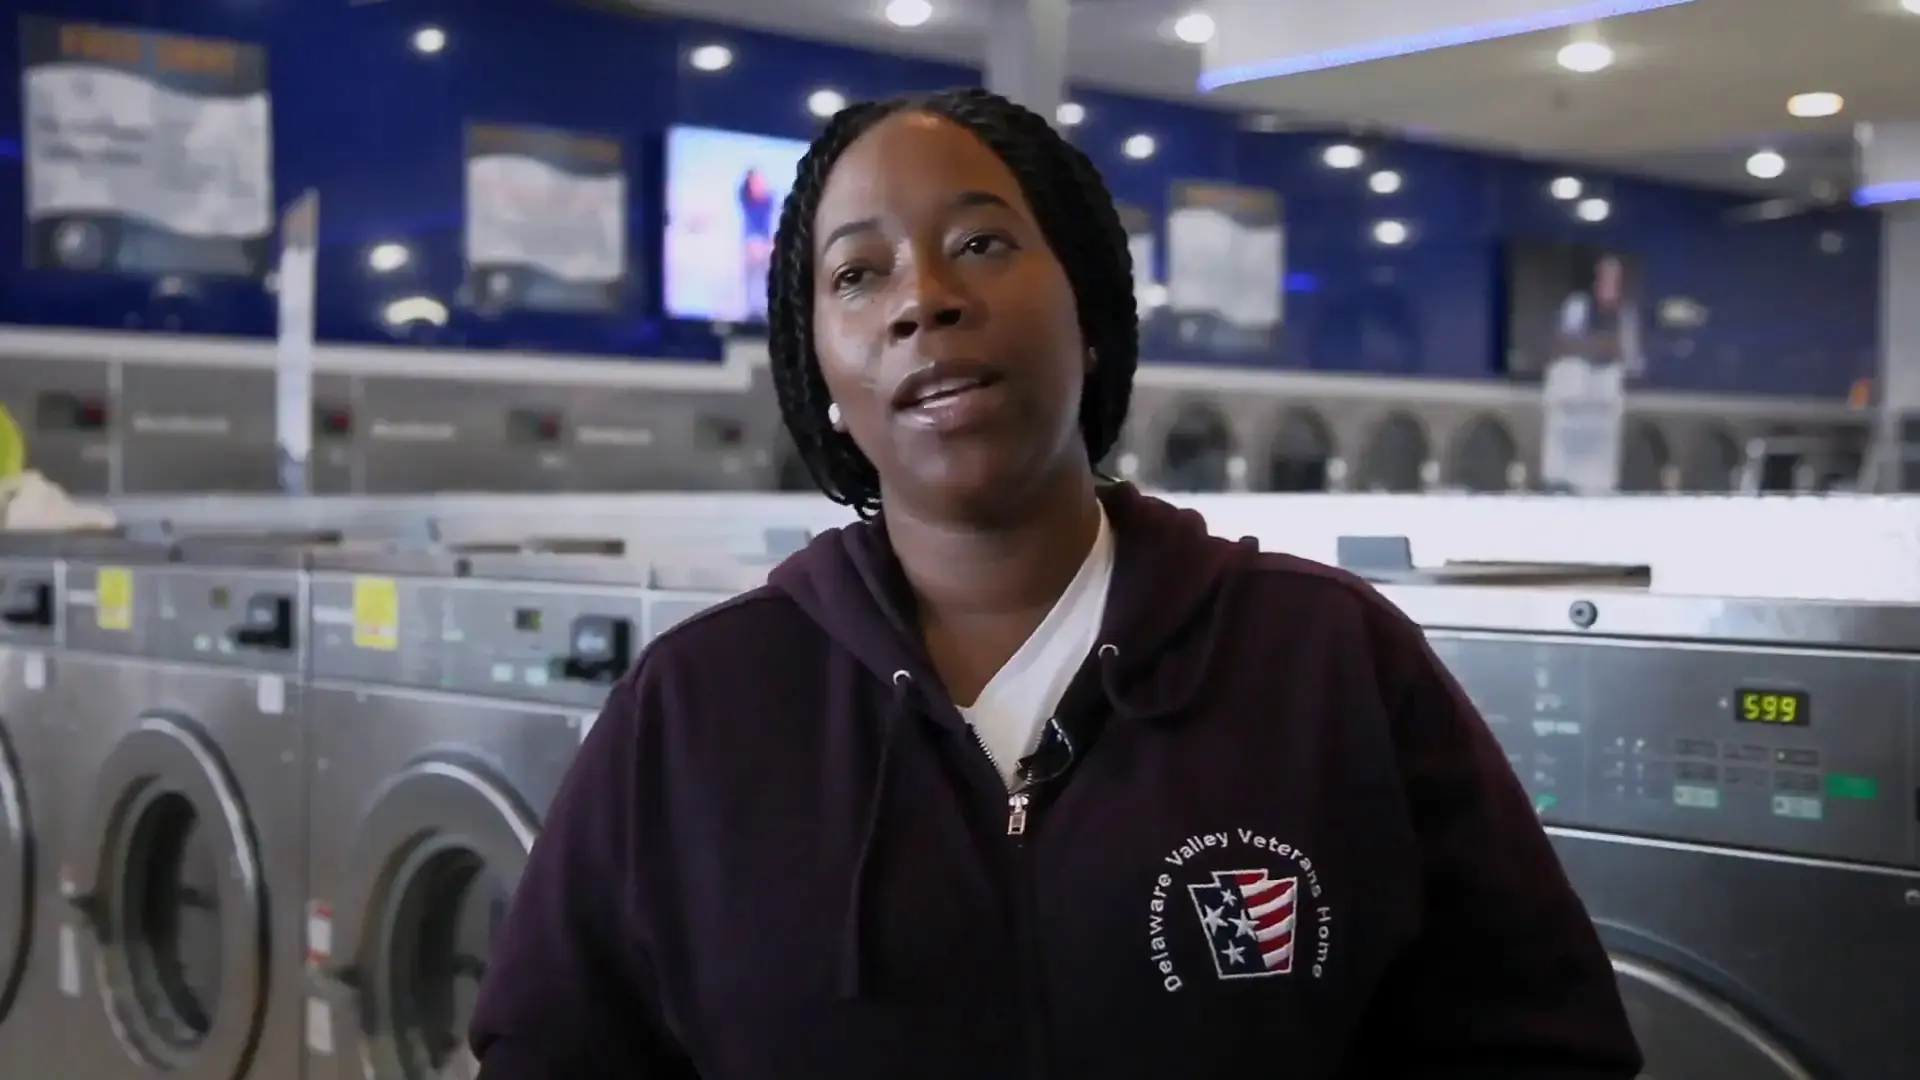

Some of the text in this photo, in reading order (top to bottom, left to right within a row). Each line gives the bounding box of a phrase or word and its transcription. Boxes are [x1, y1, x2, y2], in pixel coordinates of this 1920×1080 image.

[1743, 693, 1796, 722] 599
[1149, 828, 1332, 992] Delaware Valley Veterans Home
